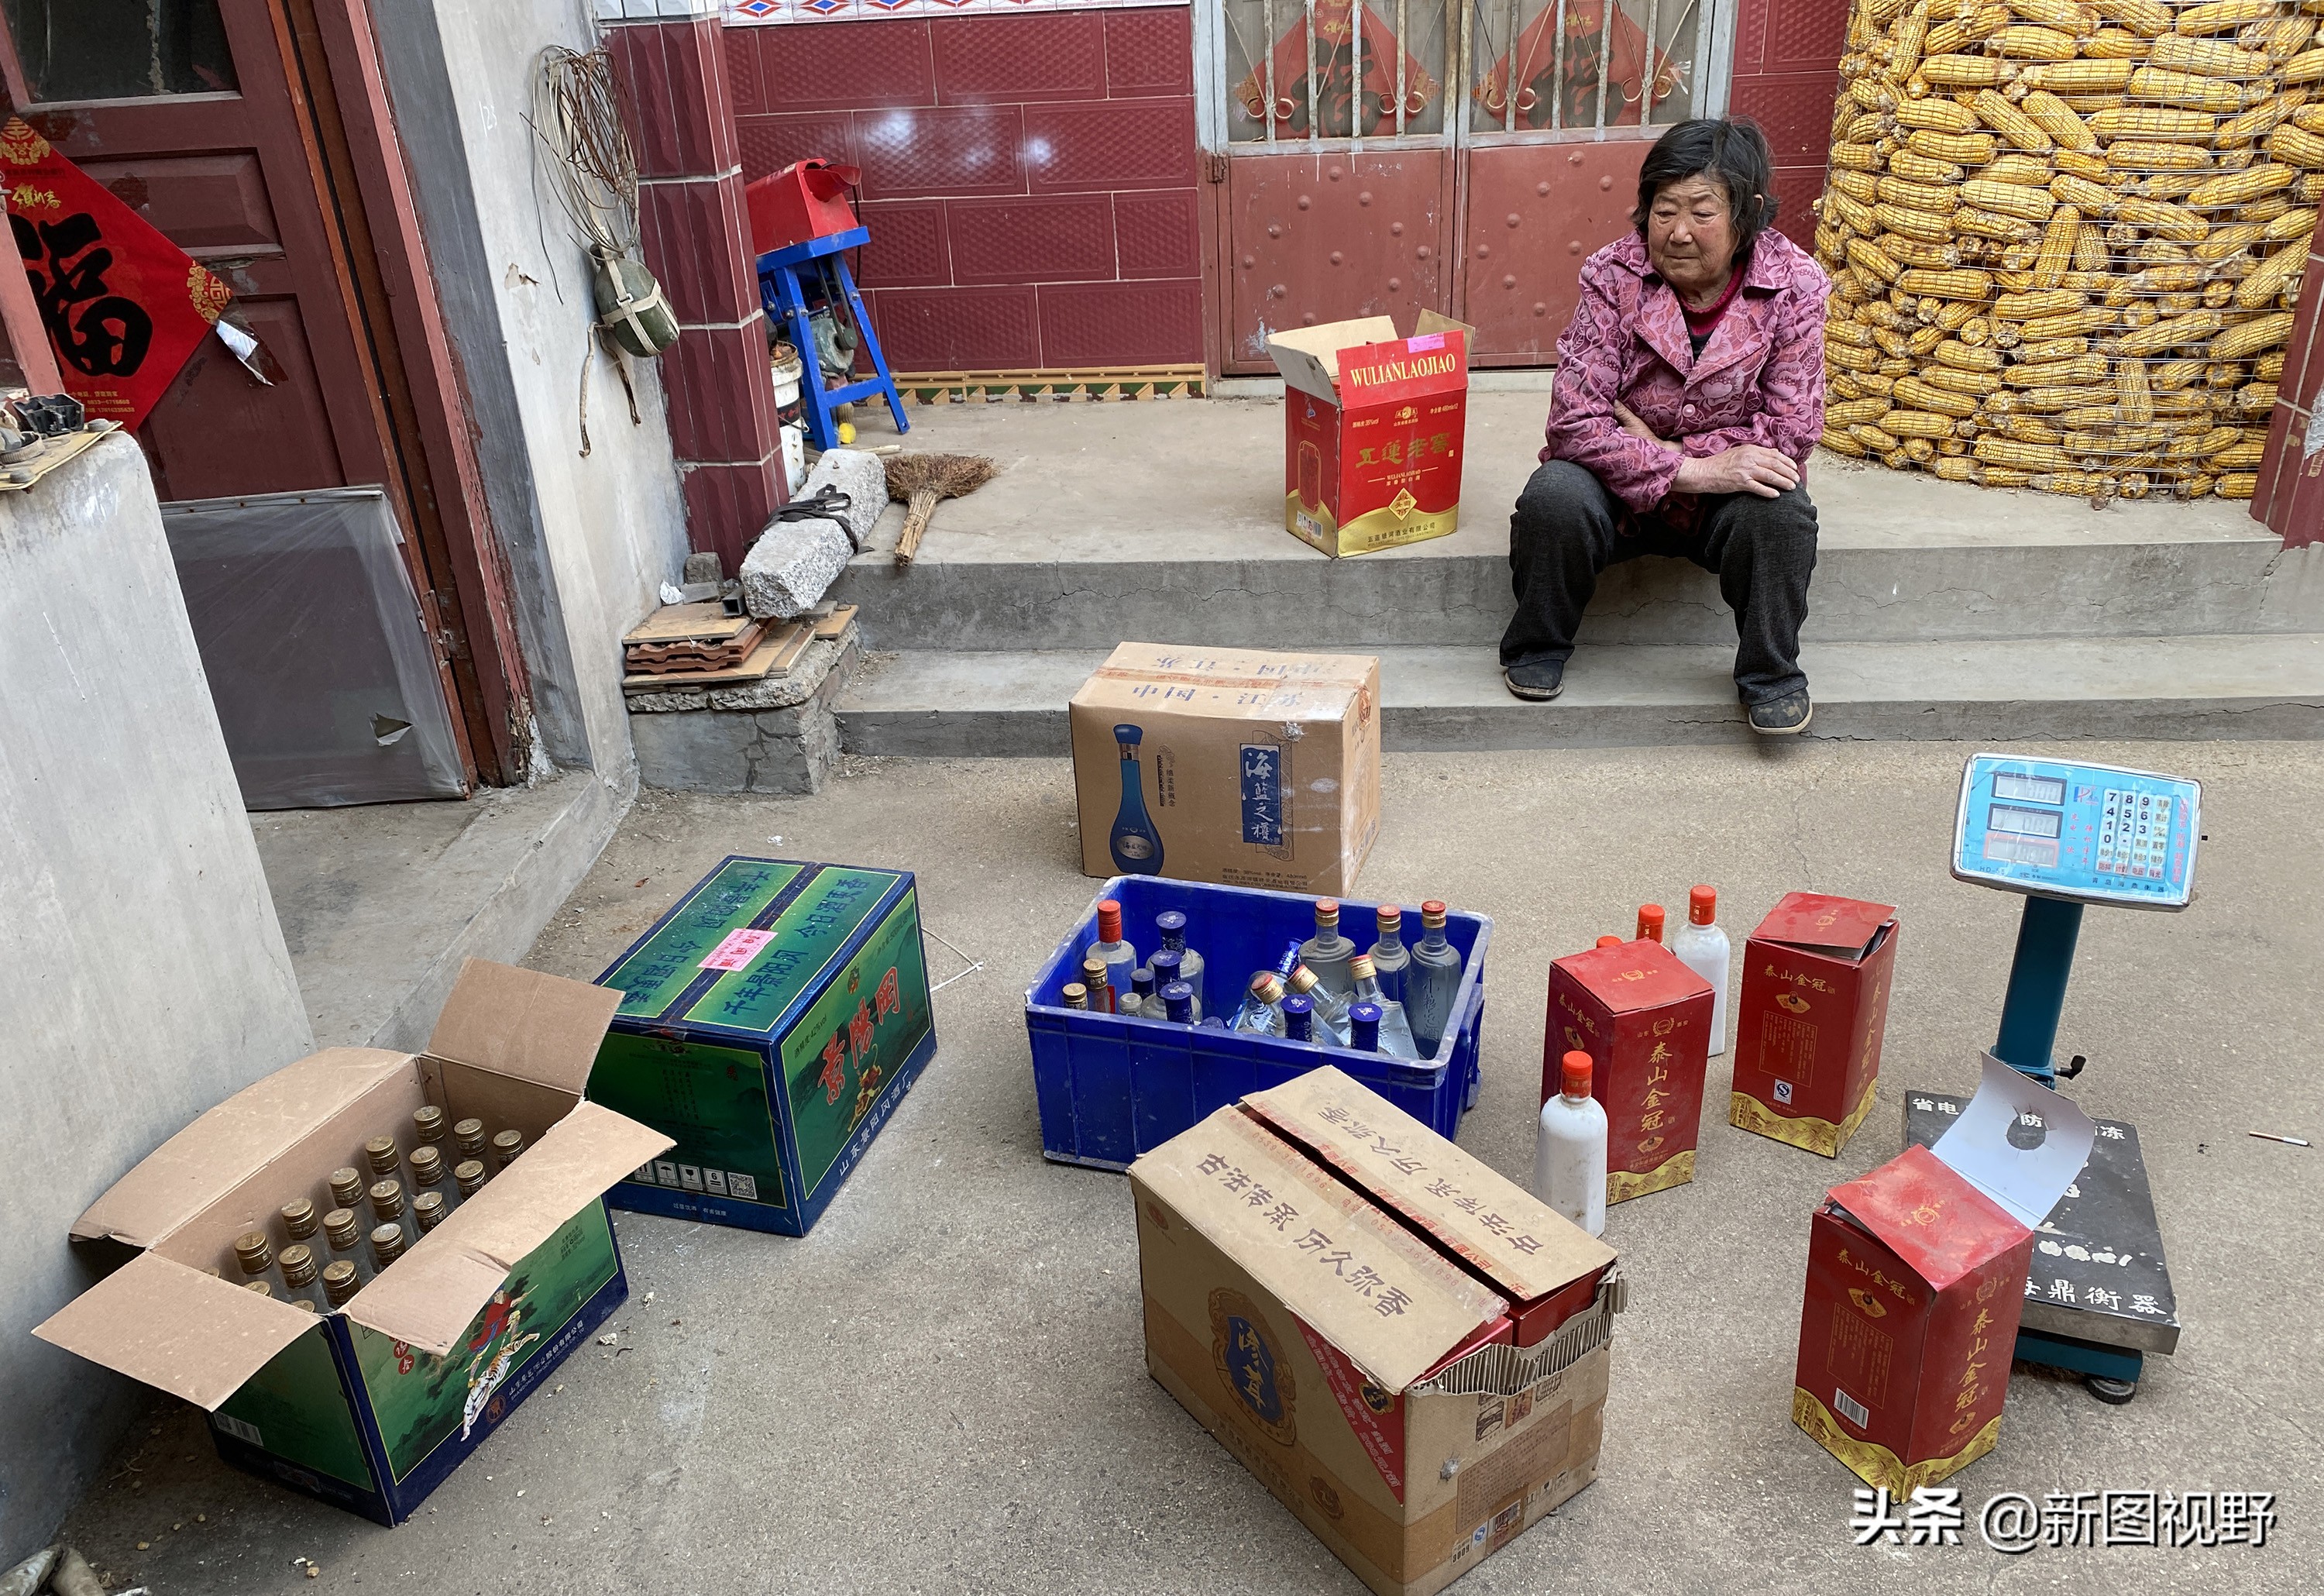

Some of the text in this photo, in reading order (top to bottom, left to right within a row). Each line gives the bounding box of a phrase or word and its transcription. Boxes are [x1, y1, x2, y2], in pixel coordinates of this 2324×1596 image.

[479, 101, 497, 136] 123
[7, 212, 153, 377] 福
[1350, 353, 1456, 387] WULIANLAOJIAO
[2107, 807, 2114, 816] 4
[2124, 810, 2131, 818] 5
[2140, 811, 2148, 820] 6
[2109, 793, 2116, 801] 7
[2126, 795, 2133, 803] 8
[2142, 797, 2150, 806] 9
[2104, 834, 2111, 843] 0
[2152, 841, 2164, 850] 置零
[2107, 821, 2147, 834] 1 2 3
[2133, 867, 2145, 875] 电压
[1765, 964, 1826, 992] 泰山金冠
[1559, 992, 1595, 1034] 泰山金冠
[1640, 1041, 1673, 1133] 泰山金冠
[1913, 1097, 1960, 1116] 省电
[2020, 1113, 2044, 1128] 防
[1195, 1154, 1300, 1232] 古法传承
[1294, 1226, 1413, 1318] 历久弥香
[1838, 1248, 1905, 1299] 泰山金冠
[1954, 1308, 1994, 1413] 泰山金冠
